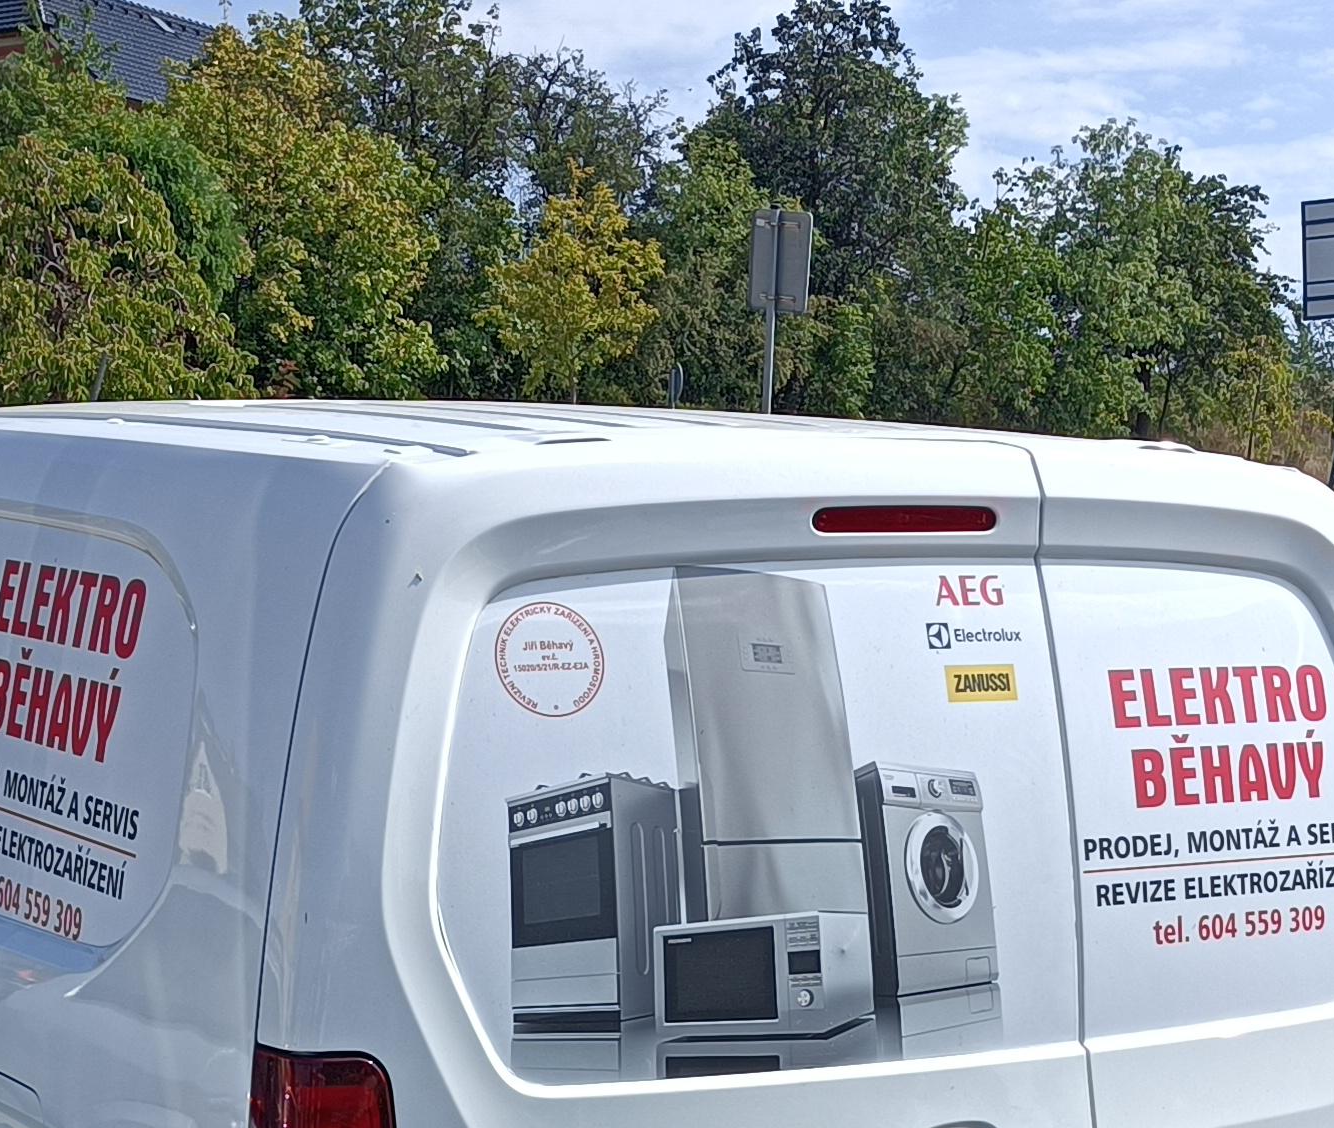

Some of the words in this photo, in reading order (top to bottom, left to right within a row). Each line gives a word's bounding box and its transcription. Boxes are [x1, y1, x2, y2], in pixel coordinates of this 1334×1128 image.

[936, 575, 1004, 606] AEG
[540, 640, 573, 651] Běhavý
[954, 628, 1022, 642] Electrolux
[953, 673, 1011, 693] ZANUSSI
[1107, 664, 1327, 728] ELEKTRO
[1131, 729, 1324, 808] BĚHAVÝ
[3, 774, 67, 815] MONTÁŽ
[67, 791, 79, 821] A
[83, 795, 139, 840] SERVIS
[1083, 833, 1180, 860] PRODEJ,
[1187, 819, 1280, 853] MONTÁŽ
[1286, 825, 1301, 846] A
[1096, 878, 1176, 907] REVIZE
[24, 888, 50, 927] 559
[54, 899, 82, 941] 309
[1153, 915, 1190, 945] tel.
[1198, 913, 1237, 941] 604
[1245, 909, 1282, 937] 559
[1289, 905, 1325, 932] 309
